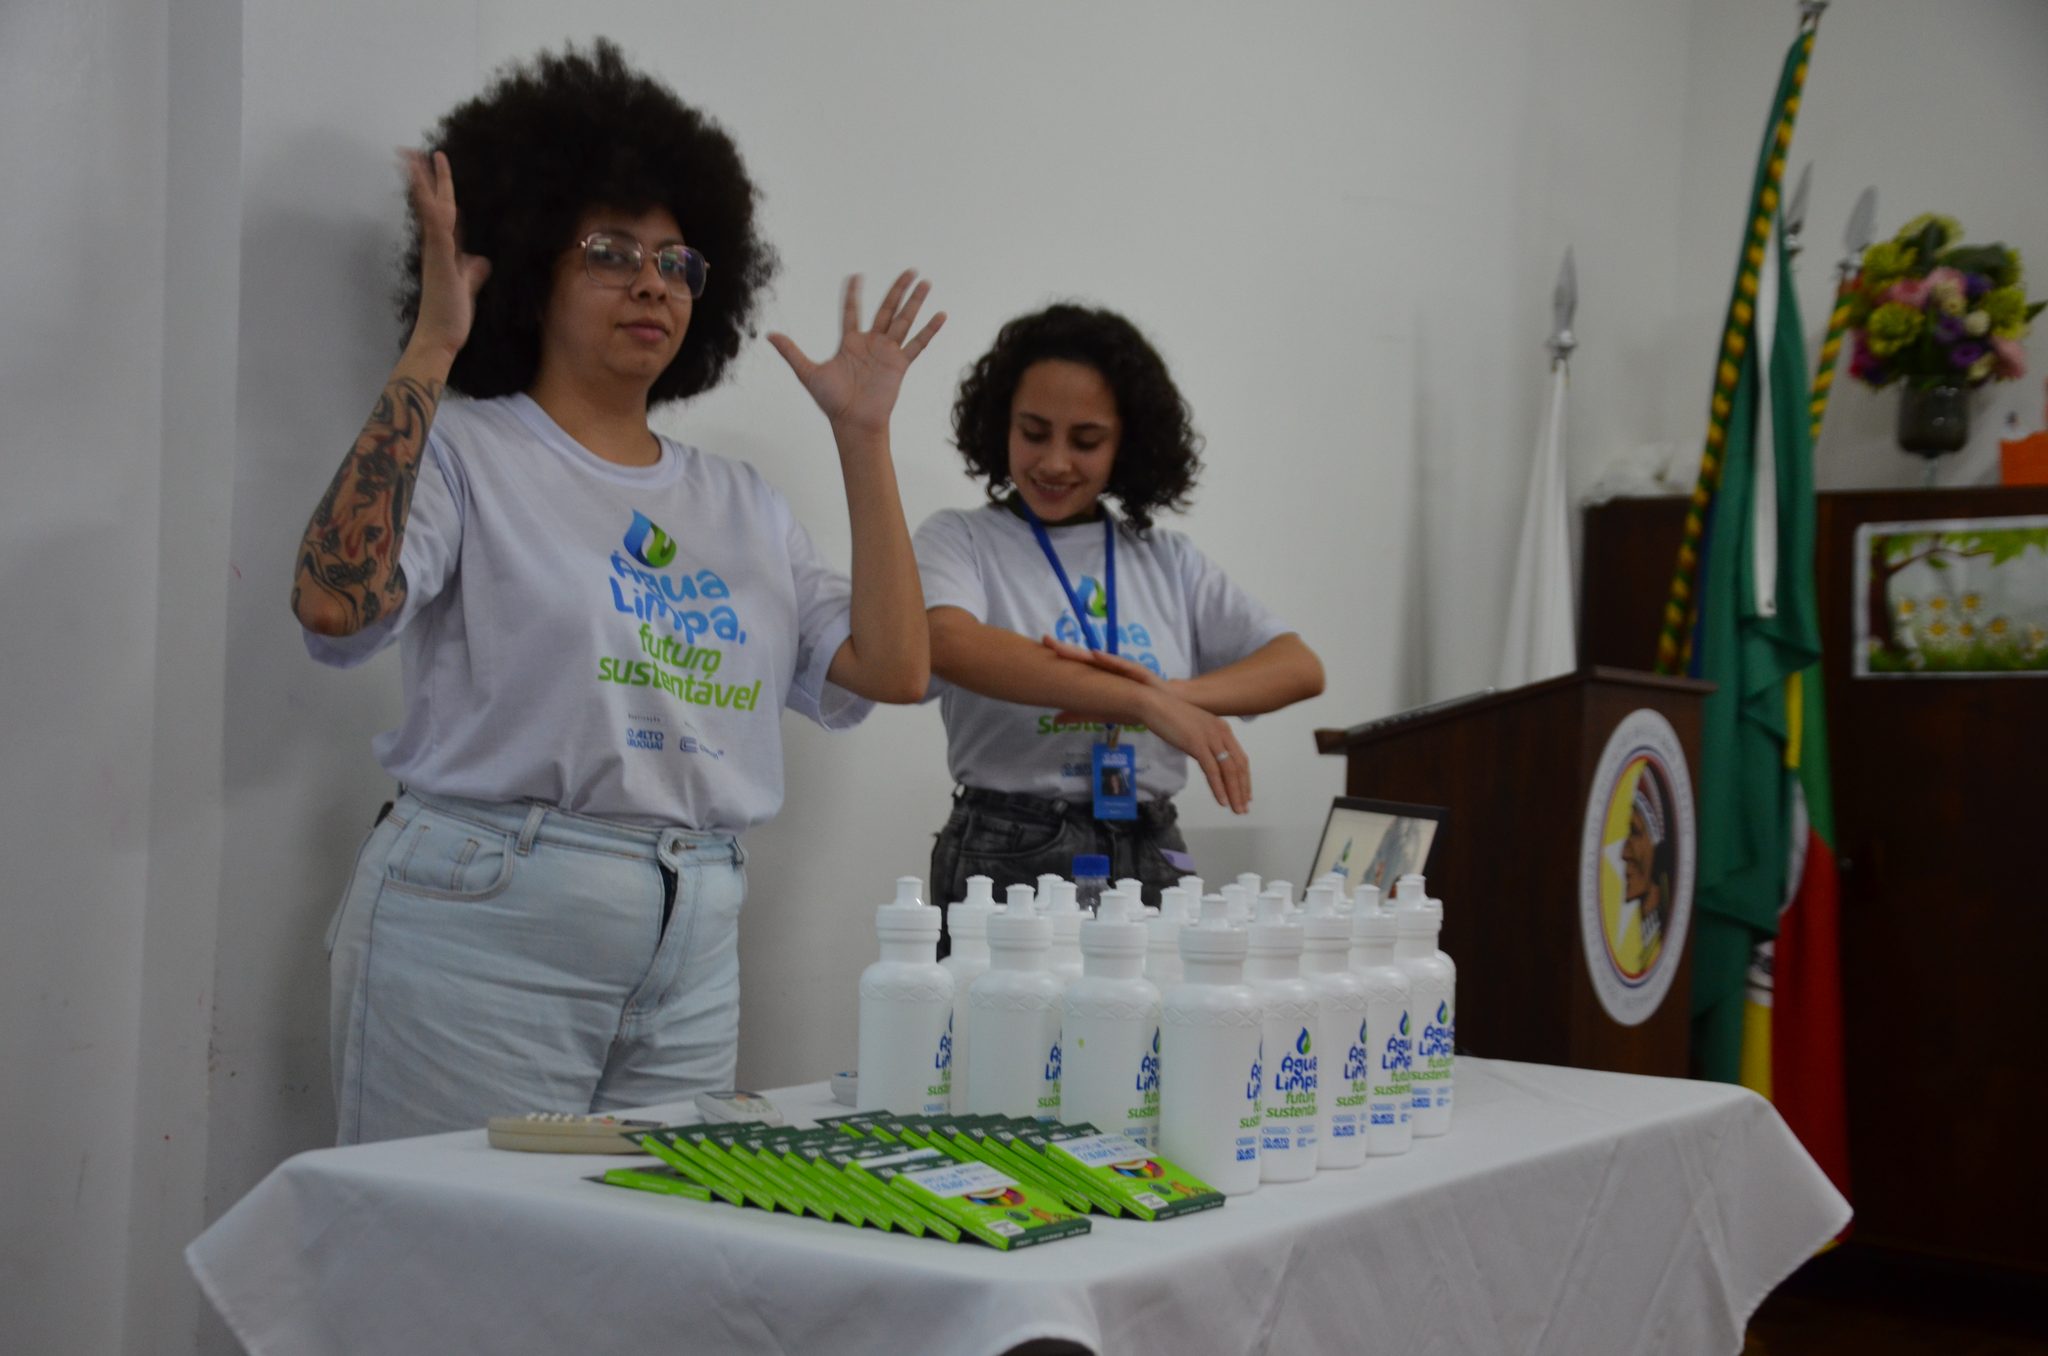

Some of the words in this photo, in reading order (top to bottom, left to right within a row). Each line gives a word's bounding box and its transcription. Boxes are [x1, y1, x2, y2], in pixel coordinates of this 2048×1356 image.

[609, 576, 746, 645] Limpa,
[638, 623, 722, 674] futuro
[597, 657, 762, 712] sustentável
